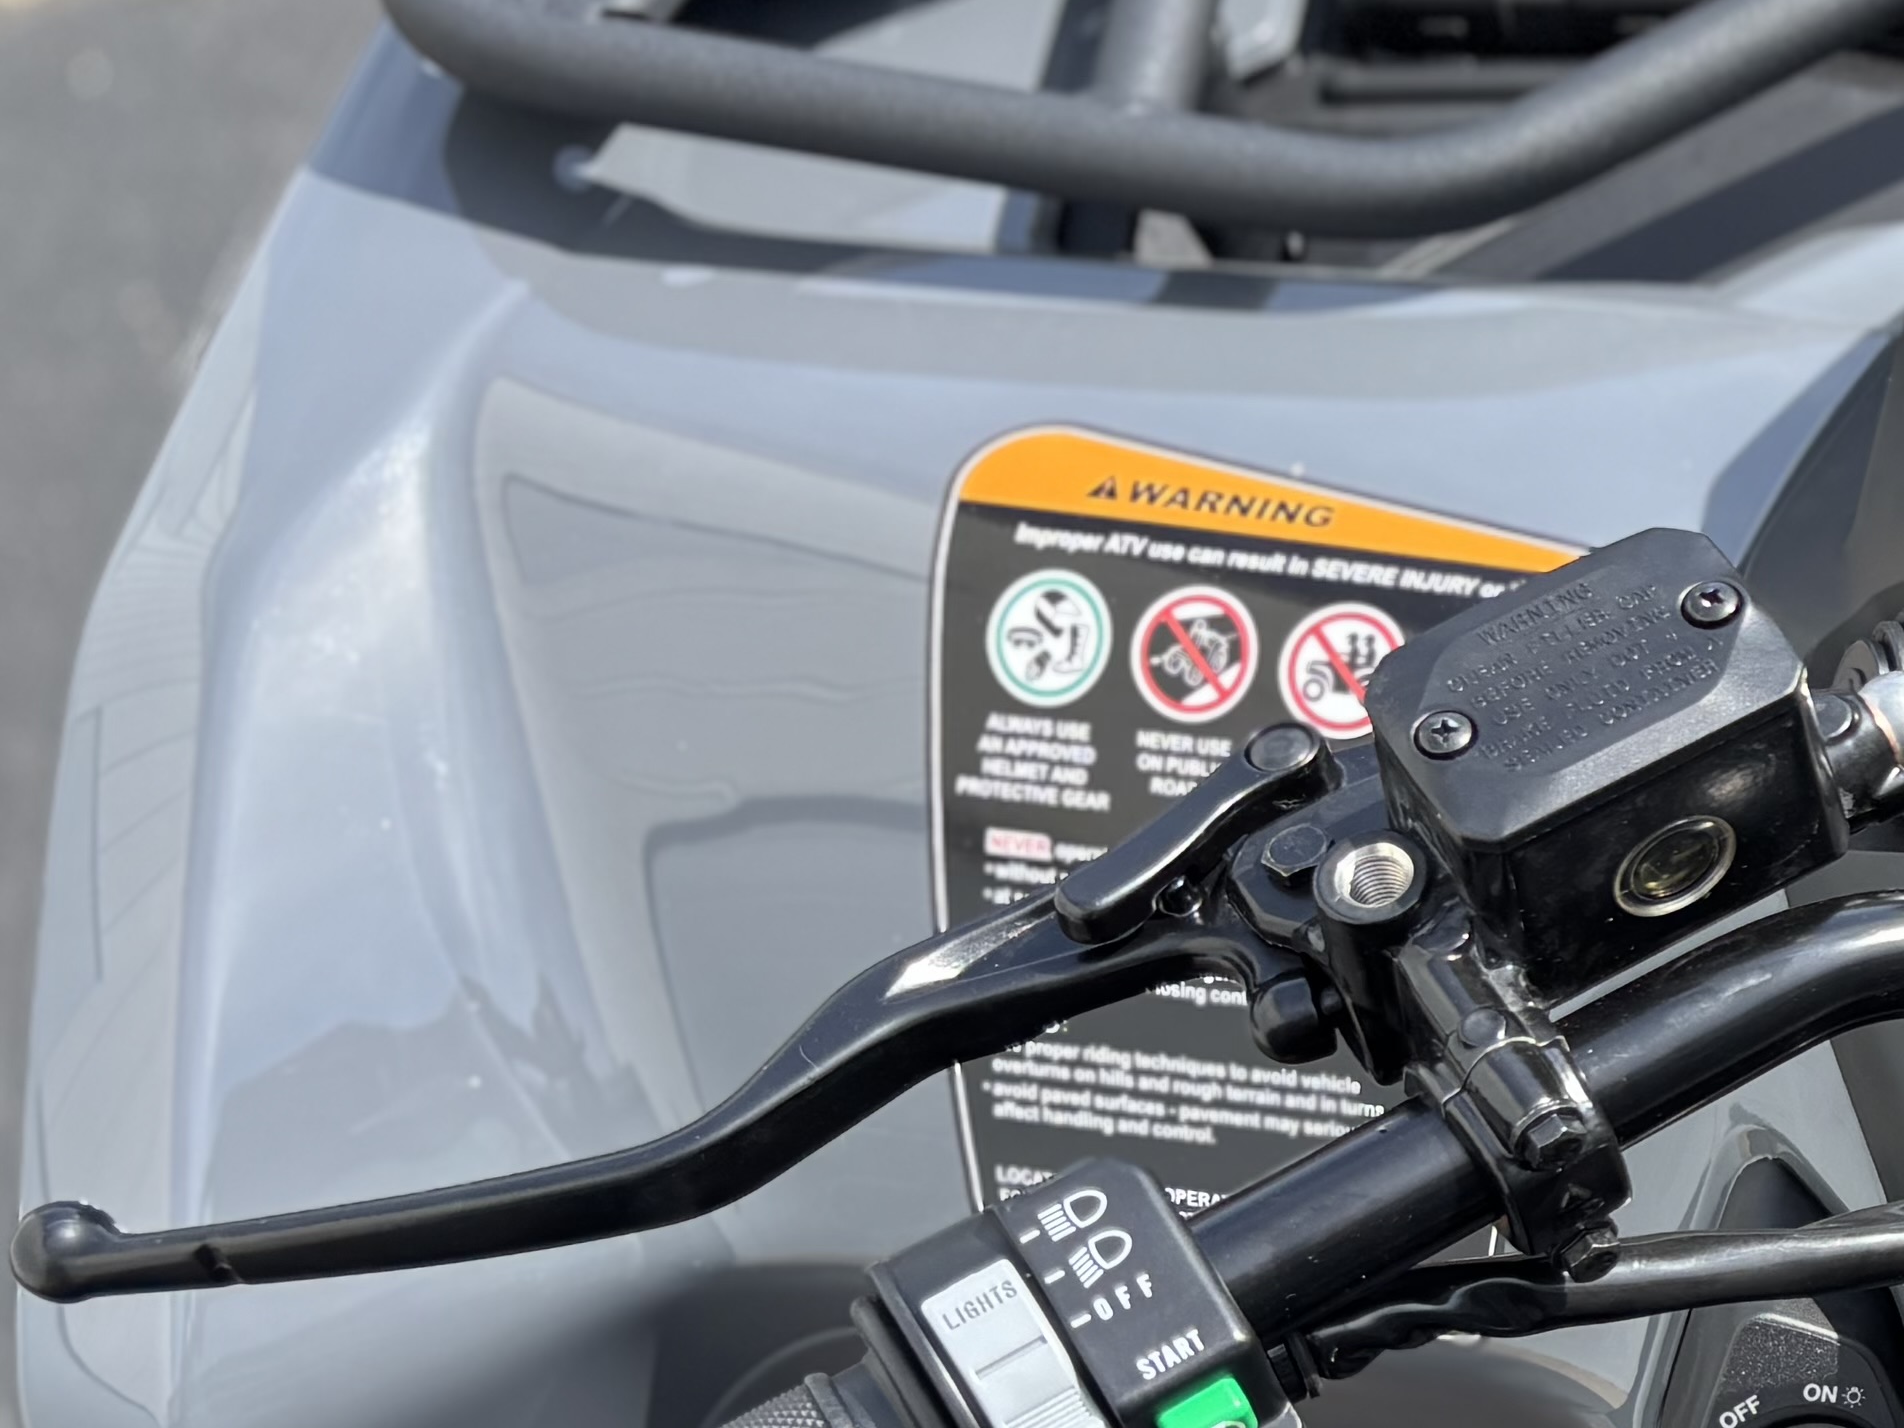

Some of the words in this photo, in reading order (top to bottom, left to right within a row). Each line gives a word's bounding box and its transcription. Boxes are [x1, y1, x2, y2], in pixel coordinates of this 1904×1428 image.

[1130, 481, 1335, 528] WARNING
[1015, 522, 1103, 553] Improper
[1104, 532, 1147, 557] ATV
[1149, 541, 1185, 563] use
[1187, 545, 1225, 567] can
[1226, 548, 1287, 574] result
[1289, 556, 1309, 578] in
[1311, 558, 1398, 586] SEVERE
[1400, 569, 1480, 596] INJURY
[1478, 582, 1593, 646] WARNING
[985, 712, 1054, 737] ALWAYS
[1055, 720, 1090, 741] USE
[1136, 730, 1194, 753] NEVER
[1196, 737, 1231, 757] USE
[980, 757, 1048, 781] HELMET
[1049, 765, 1087, 785] AND
[1005, 737, 1096, 765] APPROVED
[1136, 753, 1162, 771] ON
[954, 777, 1060, 805] PROTECTIVE
[1061, 788, 1111, 811] GEAR
[1024, 1039, 1080, 1066] proper
[1082, 1042, 1131, 1069] riding
[1133, 1051, 1227, 1084] techniques
[1229, 1062, 1249, 1081] to
[1250, 1065, 1297, 1088] avoid
[1299, 1072, 1361, 1095] vehicle
[1072, 1067, 1095, 1084] on
[1097, 1067, 1135, 1090] hills
[1136, 1073, 1170, 1093] and
[1171, 1078, 1223, 1102] rough
[1224, 1085, 1280, 1108] terrain
[1282, 1091, 1317, 1112] and
[1320, 1096, 1336, 1113] in
[991, 1081, 1038, 1102] avoid
[1040, 1086, 1091, 1112] paved
[1092, 1091, 1166, 1118] surfaces
[1178, 1103, 1261, 1130] pavement
[1263, 1113, 1300, 1137] may
[992, 1101, 1039, 1123] affect
[1041, 1106, 1114, 1136] handling
[1116, 1116, 1150, 1136] and
[1151, 1120, 1217, 1145] control.
[943, 1280, 1018, 1331] LIGHTS
[1093, 1273, 1154, 1322] OFF
[1136, 1328, 1206, 1380] START
[1803, 1383, 1839, 1405] ON
